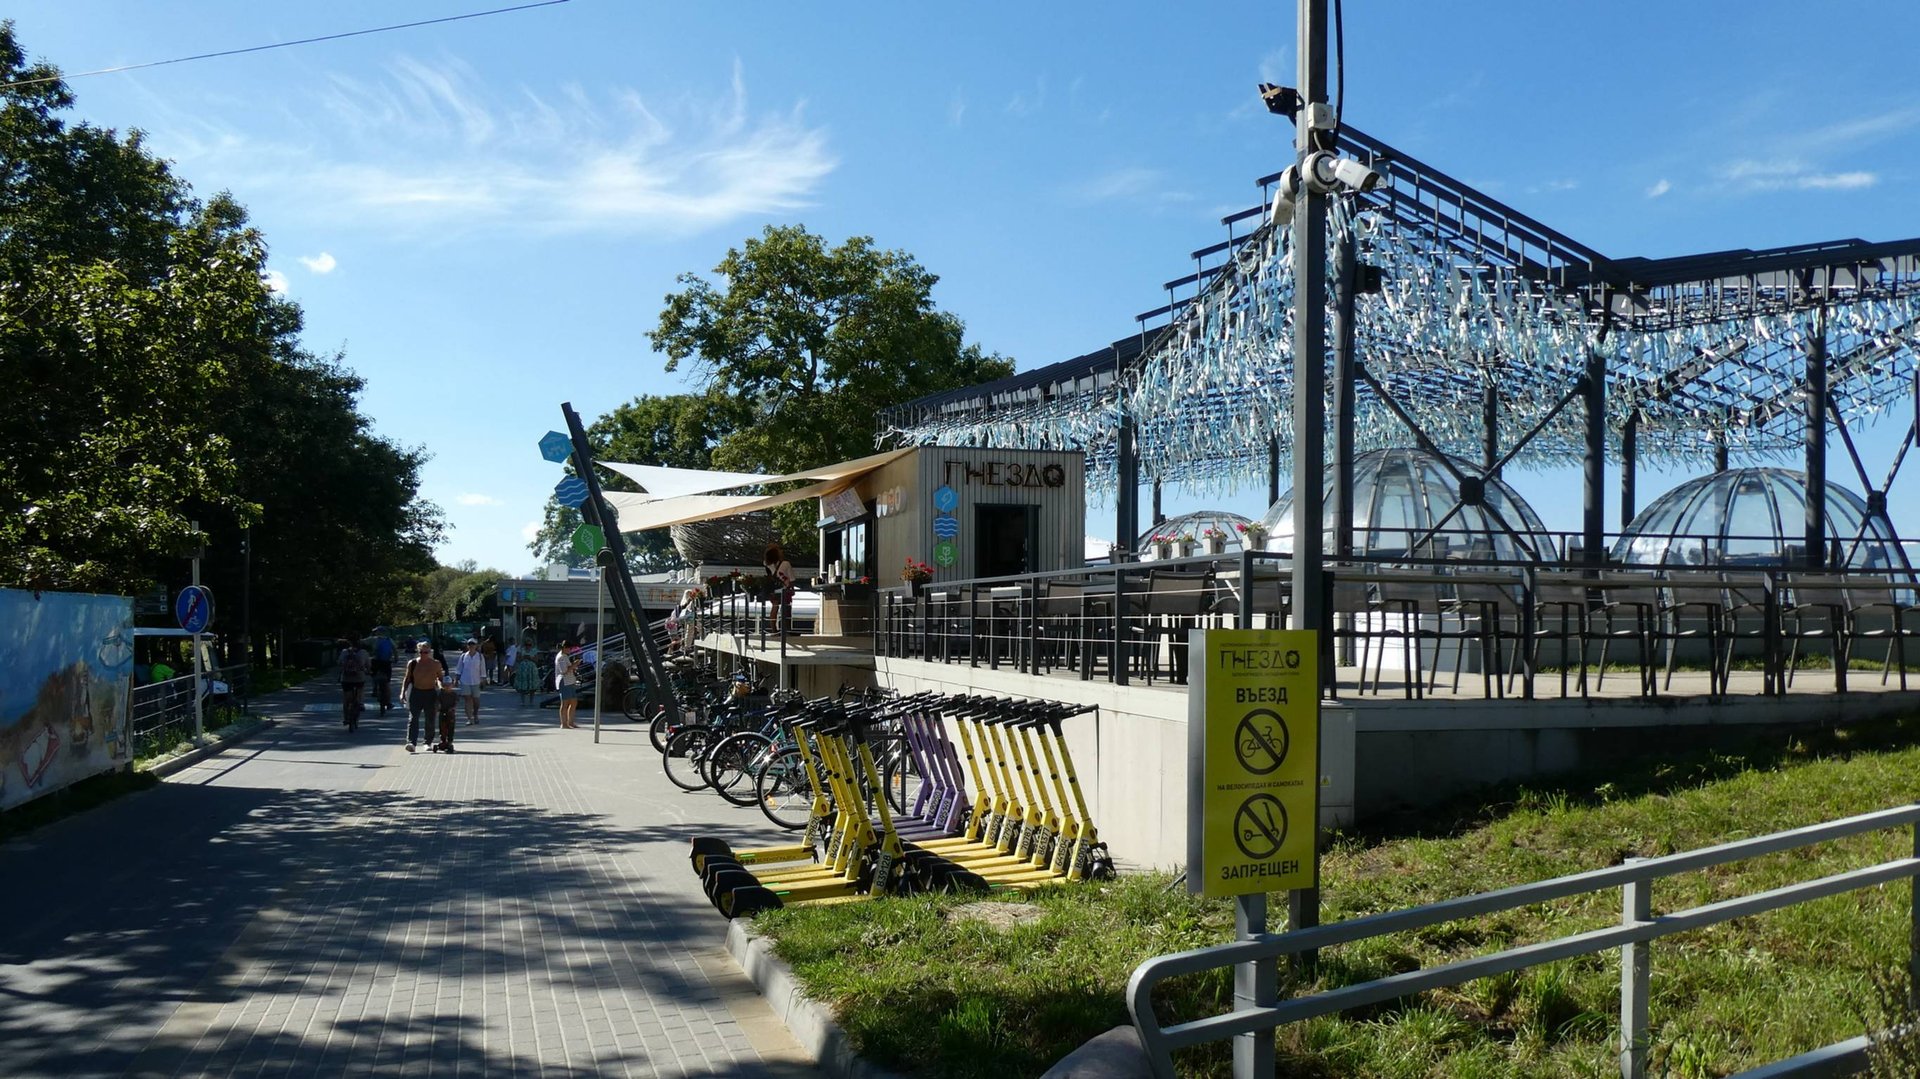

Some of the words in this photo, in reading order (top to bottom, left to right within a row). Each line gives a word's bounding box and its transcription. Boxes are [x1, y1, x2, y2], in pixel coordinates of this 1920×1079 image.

[944, 460, 1065, 488] ГНЕЗДО
[1220, 649, 1300, 670] ГНЕЗДО
[1236, 687, 1288, 705] ВЪЕЗД
[1226, 783, 1266, 791] ВЕЛОСИПЕДАХ
[1273, 780, 1304, 788] САМОКАТАХ
[1021, 827, 1032, 850] 70787
[1037, 827, 1050, 856] 861377
[1055, 839, 1068, 867] 641504
[876, 855, 891, 888] 839128
[1221, 860, 1299, 880] ЗАПРЕЩЕН
